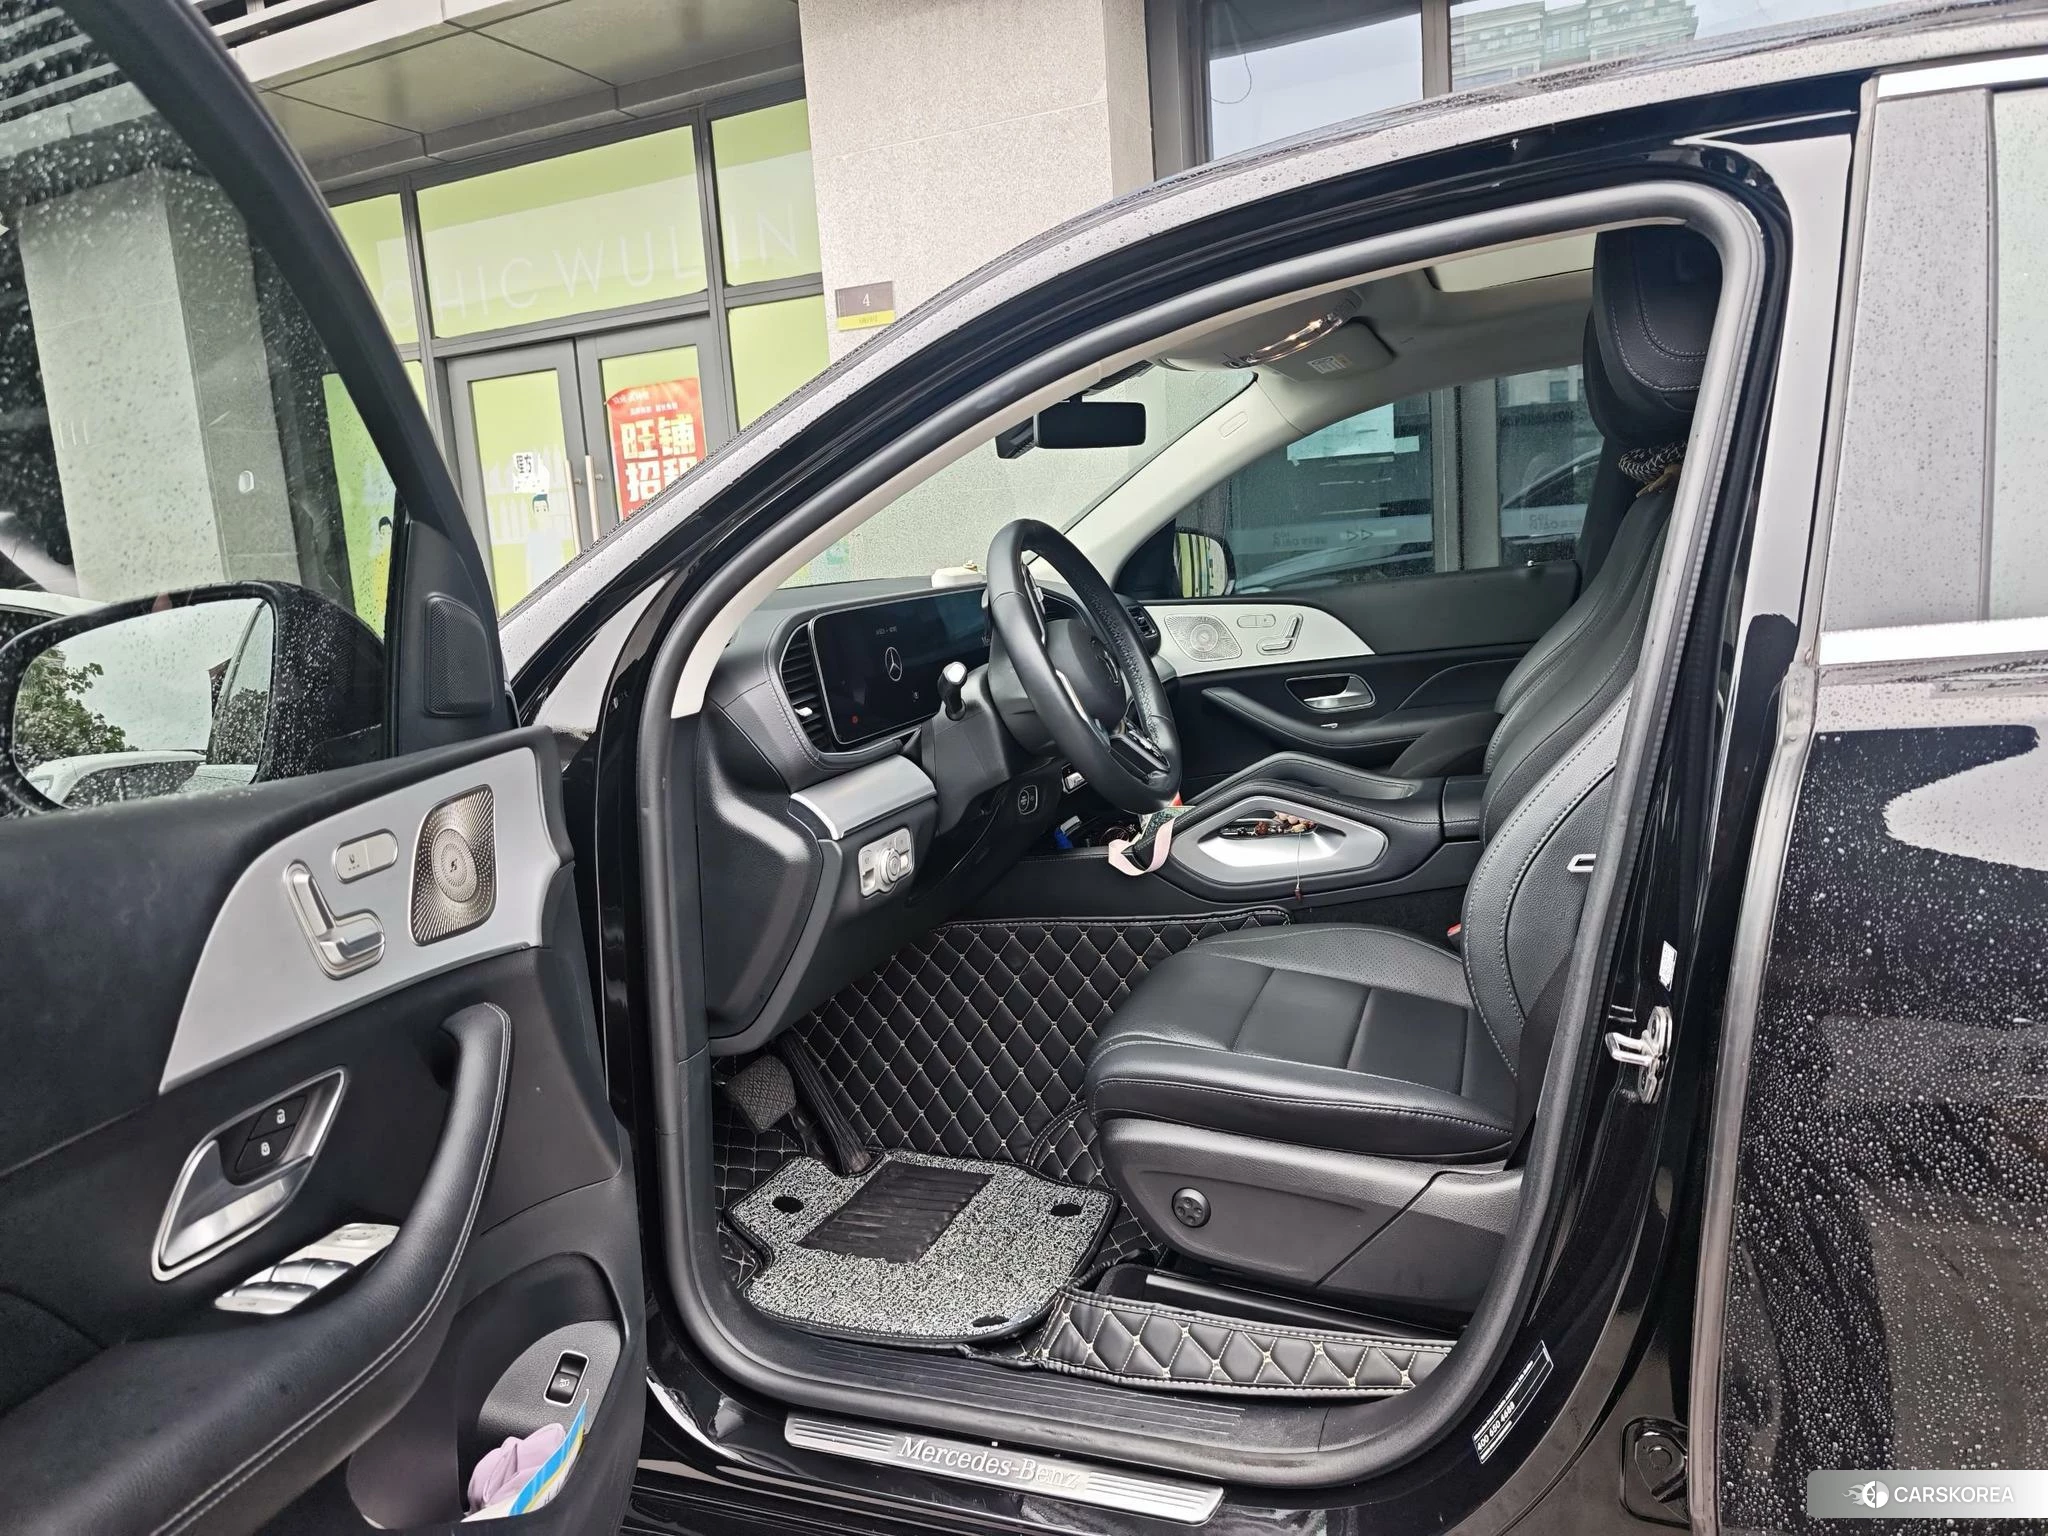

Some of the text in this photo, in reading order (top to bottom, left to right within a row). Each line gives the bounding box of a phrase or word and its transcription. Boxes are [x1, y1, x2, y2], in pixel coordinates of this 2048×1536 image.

[552, 204, 800, 298] WULIN
[862, 293, 871, 307] 4
[620, 413, 697, 460] 旺铺
[897, 1436, 1082, 1490] Mercedes-Benz
